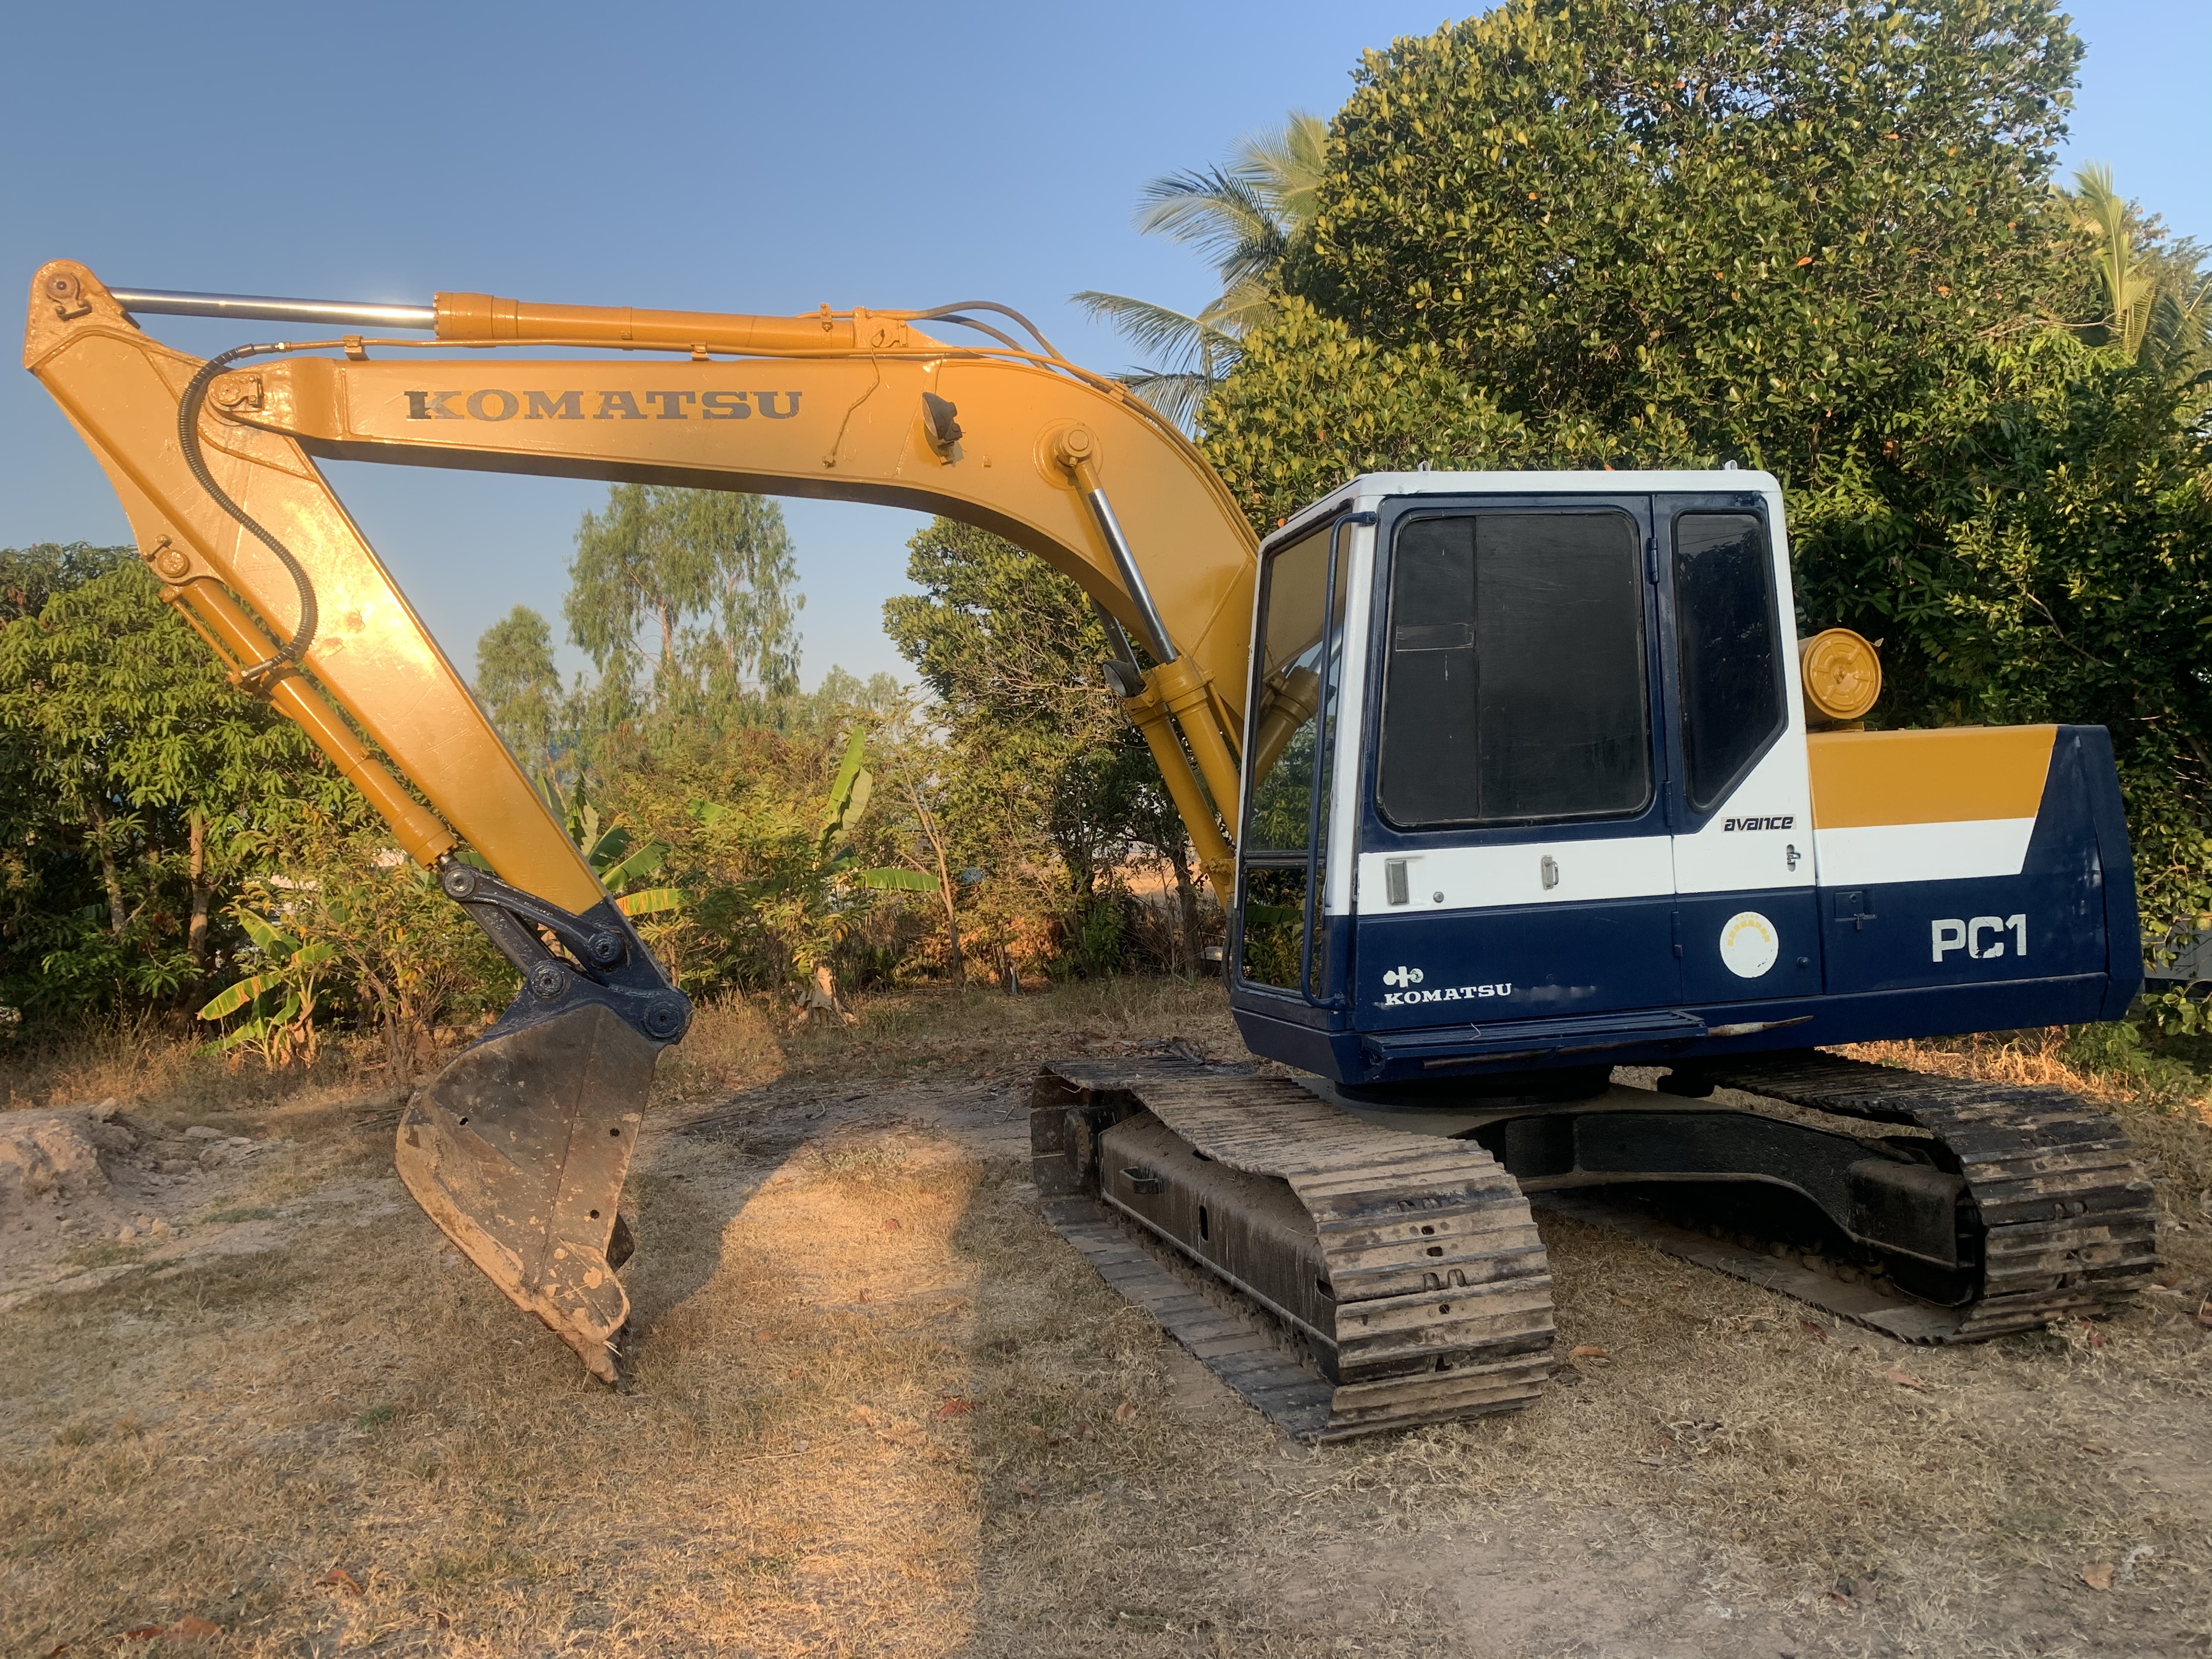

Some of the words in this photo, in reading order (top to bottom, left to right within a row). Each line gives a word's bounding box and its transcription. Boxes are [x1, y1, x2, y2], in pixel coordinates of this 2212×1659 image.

[404, 389, 802, 421] KOMATSU
[1724, 816, 1793, 832] avance
[1932, 913, 2027, 962] PC1
[1384, 983, 1511, 1006] KOMATSU
